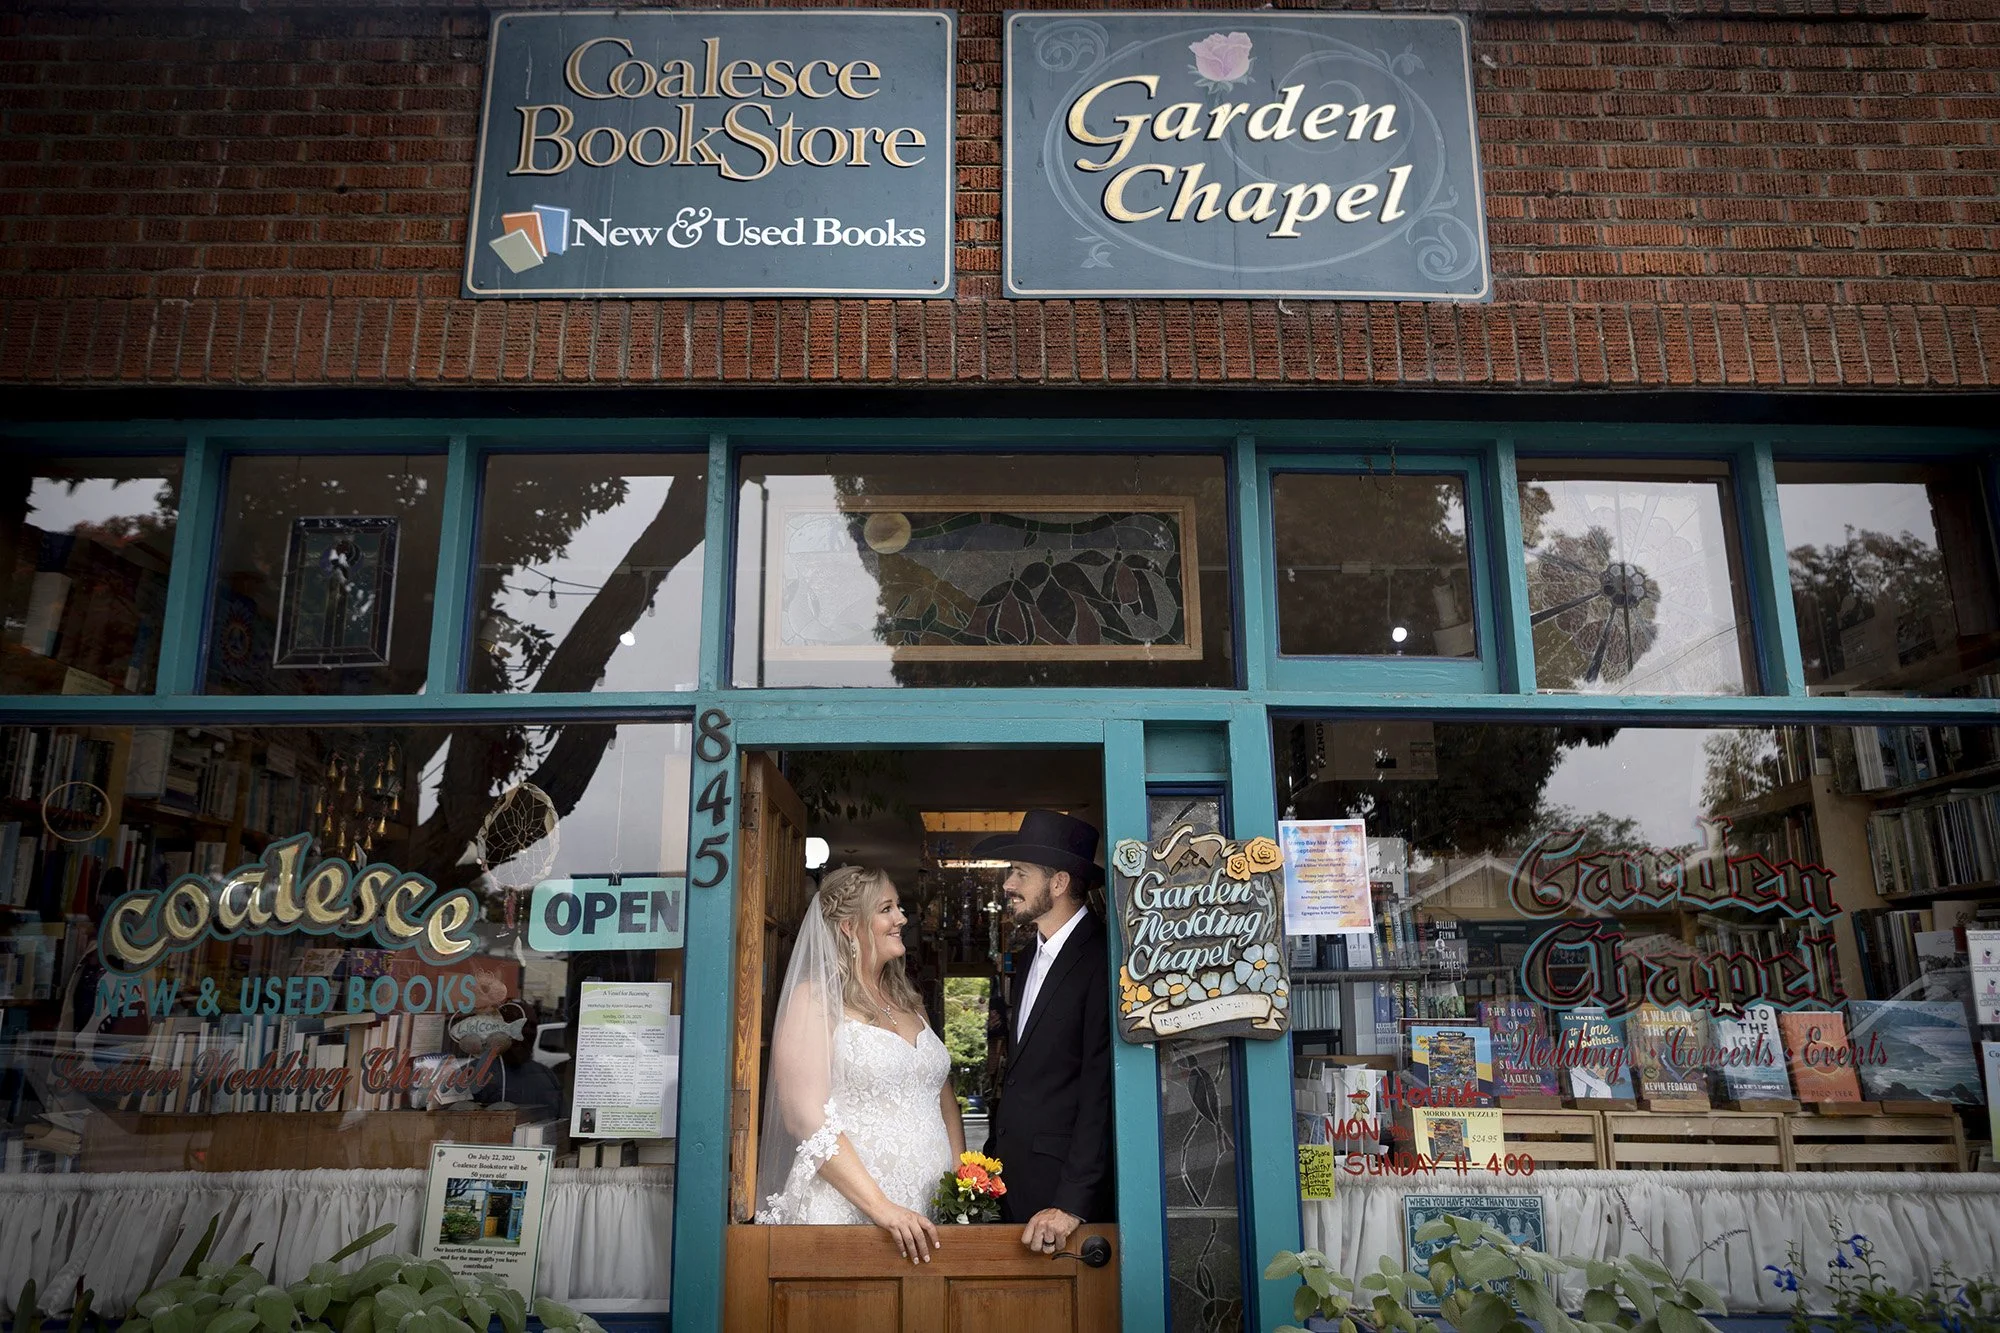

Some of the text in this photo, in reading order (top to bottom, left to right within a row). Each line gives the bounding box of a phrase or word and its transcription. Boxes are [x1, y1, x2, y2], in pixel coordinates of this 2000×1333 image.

[566, 37, 881, 99] Coalesce
[509, 102, 927, 182] BookStore
[1066, 75, 1399, 171] Garden
[1102, 162, 1414, 239] Chapel
[572, 206, 926, 249] New & Used Books
[692, 709, 732, 888] 845
[1509, 816, 1844, 923] Garden
[107, 838, 476, 968] coalesce
[1134, 868, 1253, 911] Garden
[544, 890, 681, 936] OPEN
[1129, 907, 1262, 948] Wedding
[1436, 921, 1457, 929] GILLIAN
[1439, 931, 1455, 939] FLYNN
[1128, 938, 1235, 981] Chapel
[1521, 921, 1848, 1020] Chapel
[96, 974, 478, 1017] NEW & USED BOOKS
[1487, 1008, 1536, 1017] THE BOOK
[1507, 1021, 1519, 1030] OF
[1583, 1022, 1611, 1039] Love
[1643, 1010, 1691, 1022] A WALK IN
[1645, 1025, 1665, 1036] THE
[1737, 1023, 1768, 1034] THE
[1512, 1023, 1889, 1084] Weddings Concerts Events
[1568, 1035, 1619, 1048] Hpothesis
[51, 1046, 498, 1110] Garden Wedding Chapel
[1381, 1074, 1491, 1111] Hours
[1503, 1074, 1541, 1083] JAOUAD
[1645, 1082, 1697, 1091] KEVIN FEDARKO
[1325, 1118, 1379, 1142] MON
[1472, 1135, 1498, 1143] $24.95
[1343, 1152, 1445, 1176] SUNDAY
[1410, 1198, 1538, 1207] WHEN YOU HAVE MORE THAN YOU NEED
